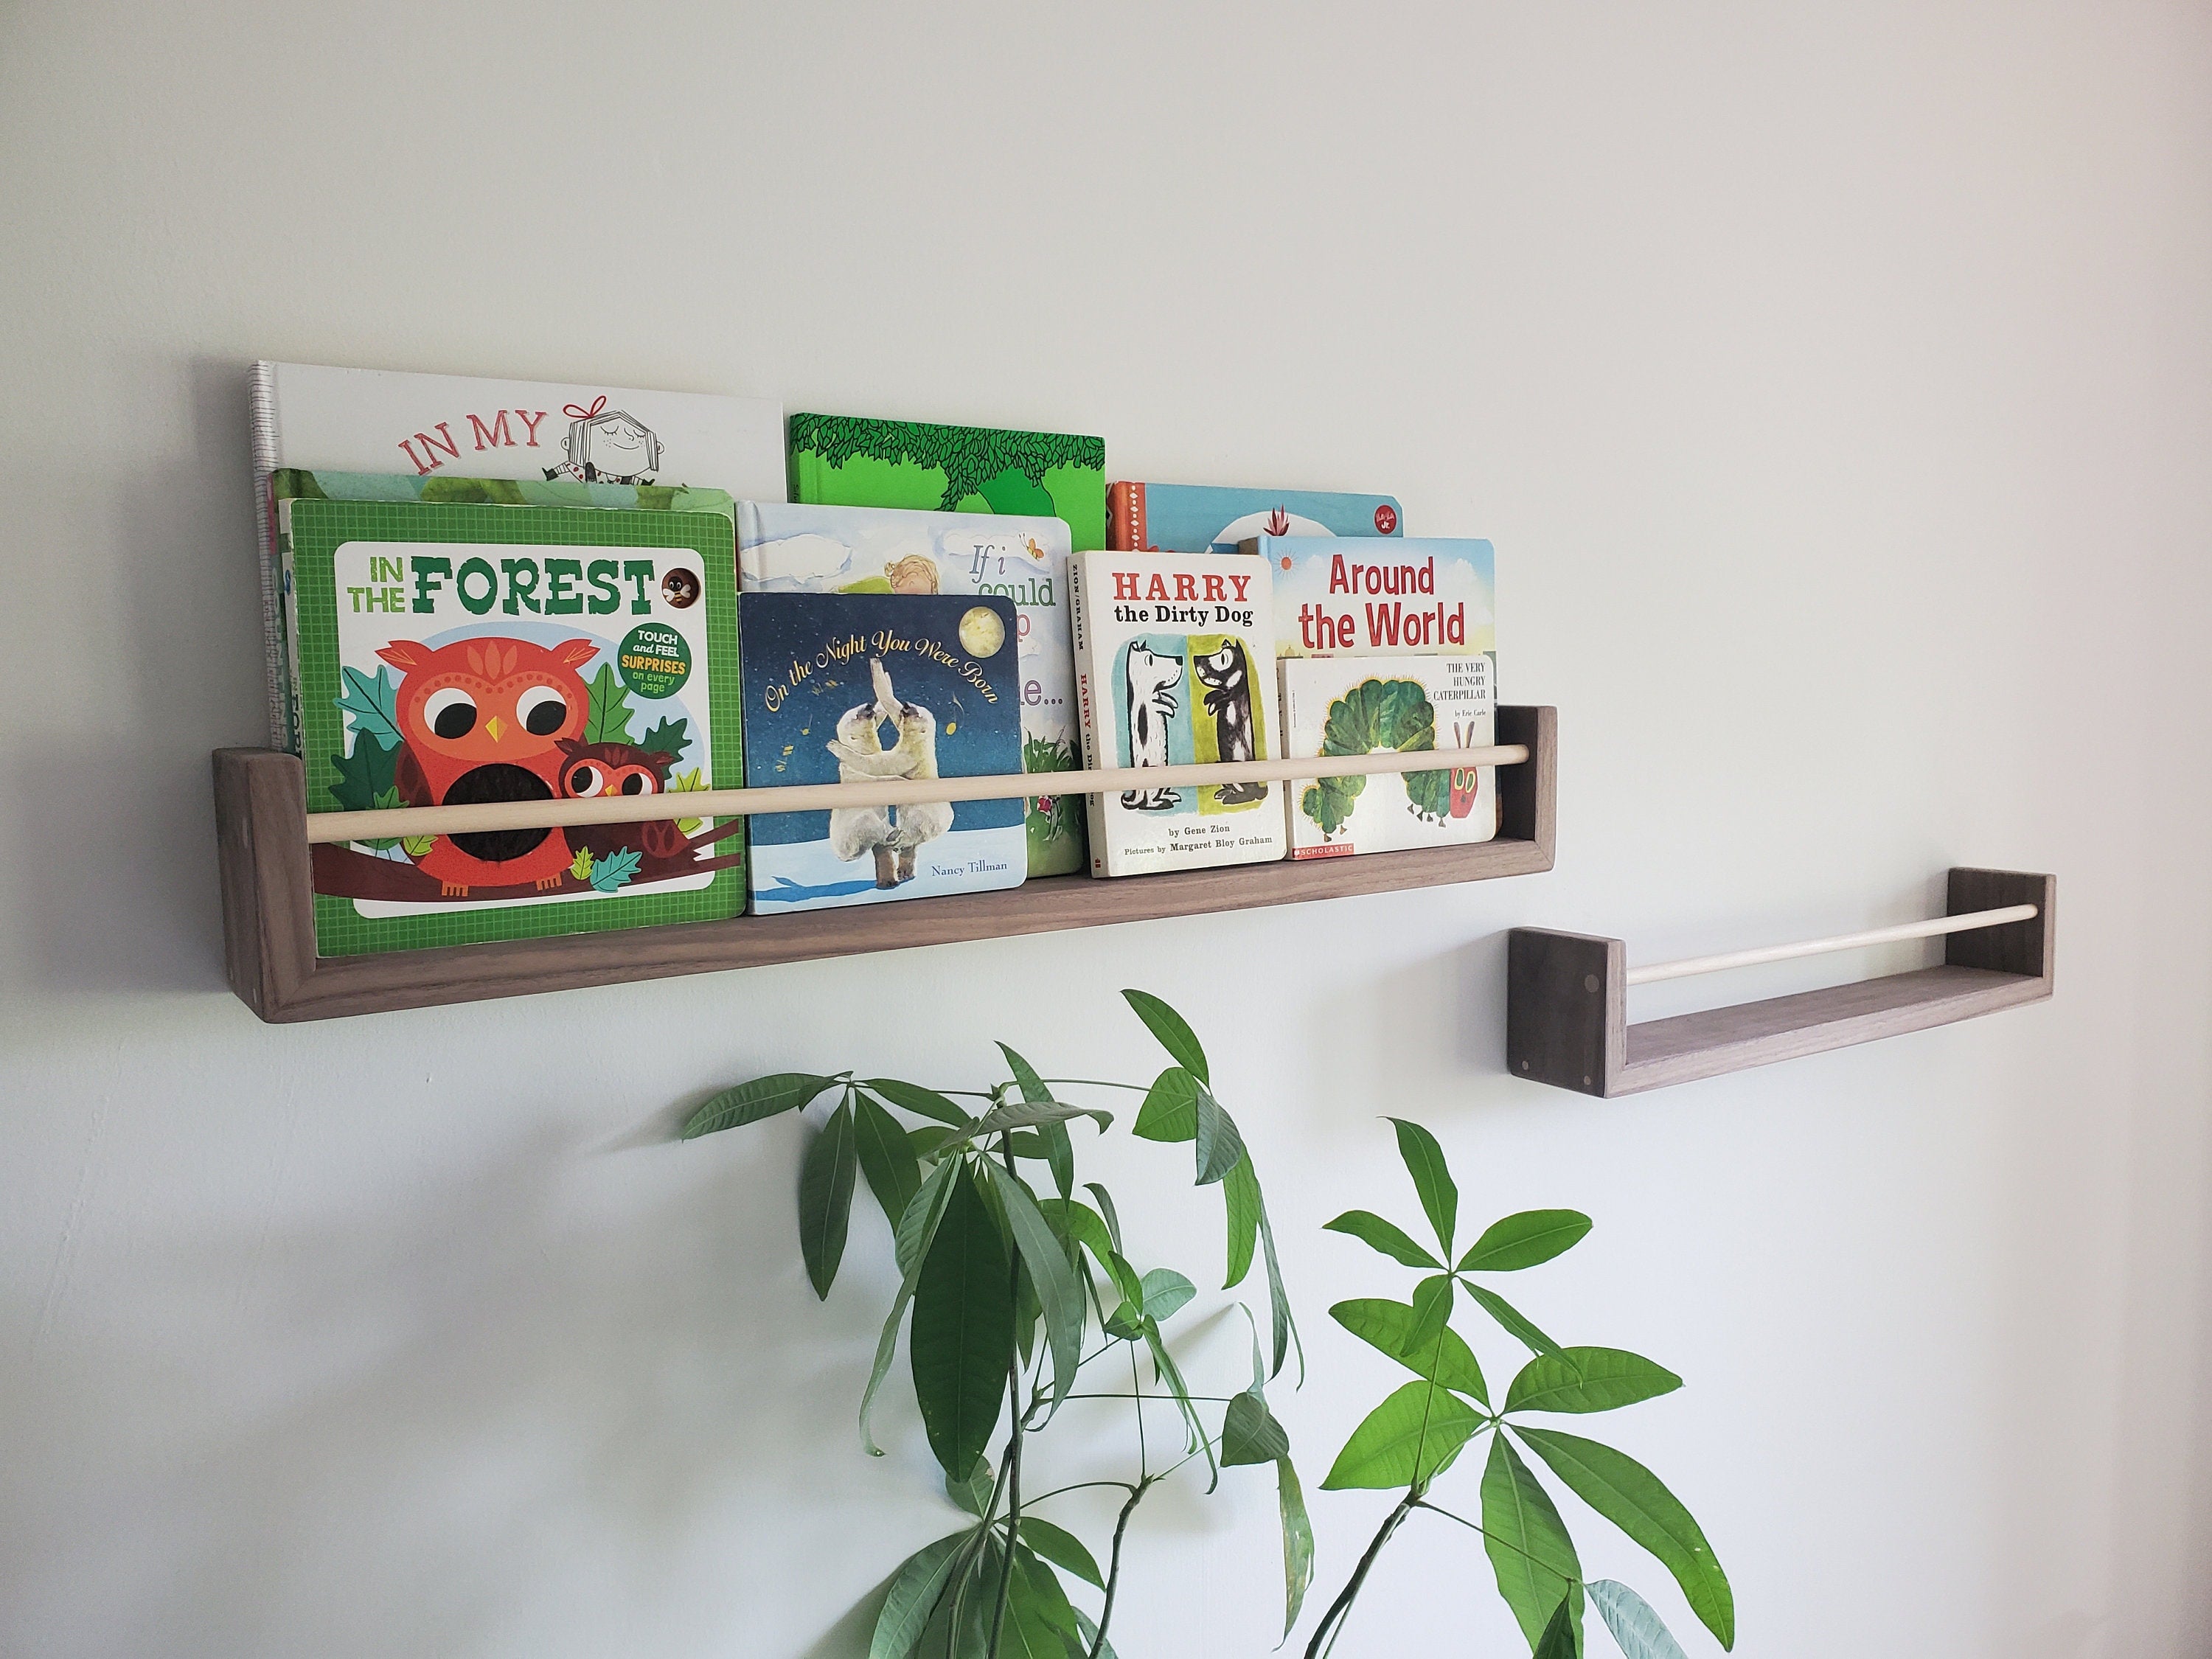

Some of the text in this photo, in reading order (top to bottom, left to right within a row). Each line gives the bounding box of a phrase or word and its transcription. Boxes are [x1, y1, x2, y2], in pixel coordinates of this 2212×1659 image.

[397, 410, 548, 476] IN MY
[369, 556, 404, 582] IN
[969, 545, 1006, 583] If i
[1329, 554, 1434, 595] Around
[411, 556, 655, 615] FOREST
[1112, 573, 1251, 602] HARRY
[347, 587, 406, 613] THE
[1073, 564, 1085, 650] ZION/GRAHAM
[1114, 605, 1253, 627] the Dirty Dog
[1298, 602, 1465, 650] the World
[638, 630, 678, 645] TOUCH
[633, 644, 679, 657] and FEEL
[622, 654, 686, 675] SURPRISES
[765, 630, 998, 712] On the Night You Were Born
[1446, 662, 1485, 673] THE VERY
[633, 672, 675, 686] on every
[640, 682, 665, 694] page
[1453, 675, 1485, 686] HUNGRY
[1081, 673, 1091, 728] HARRY
[1433, 689, 1486, 700] CATERPILLAR
[1169, 824, 1230, 838] by Gene Zion
[1124, 835, 1273, 855] Pictures by Margaret Bloy Graham
[1301, 845, 1352, 855] SCHOLASTIC
[931, 861, 1008, 877] Nancy Tillman
